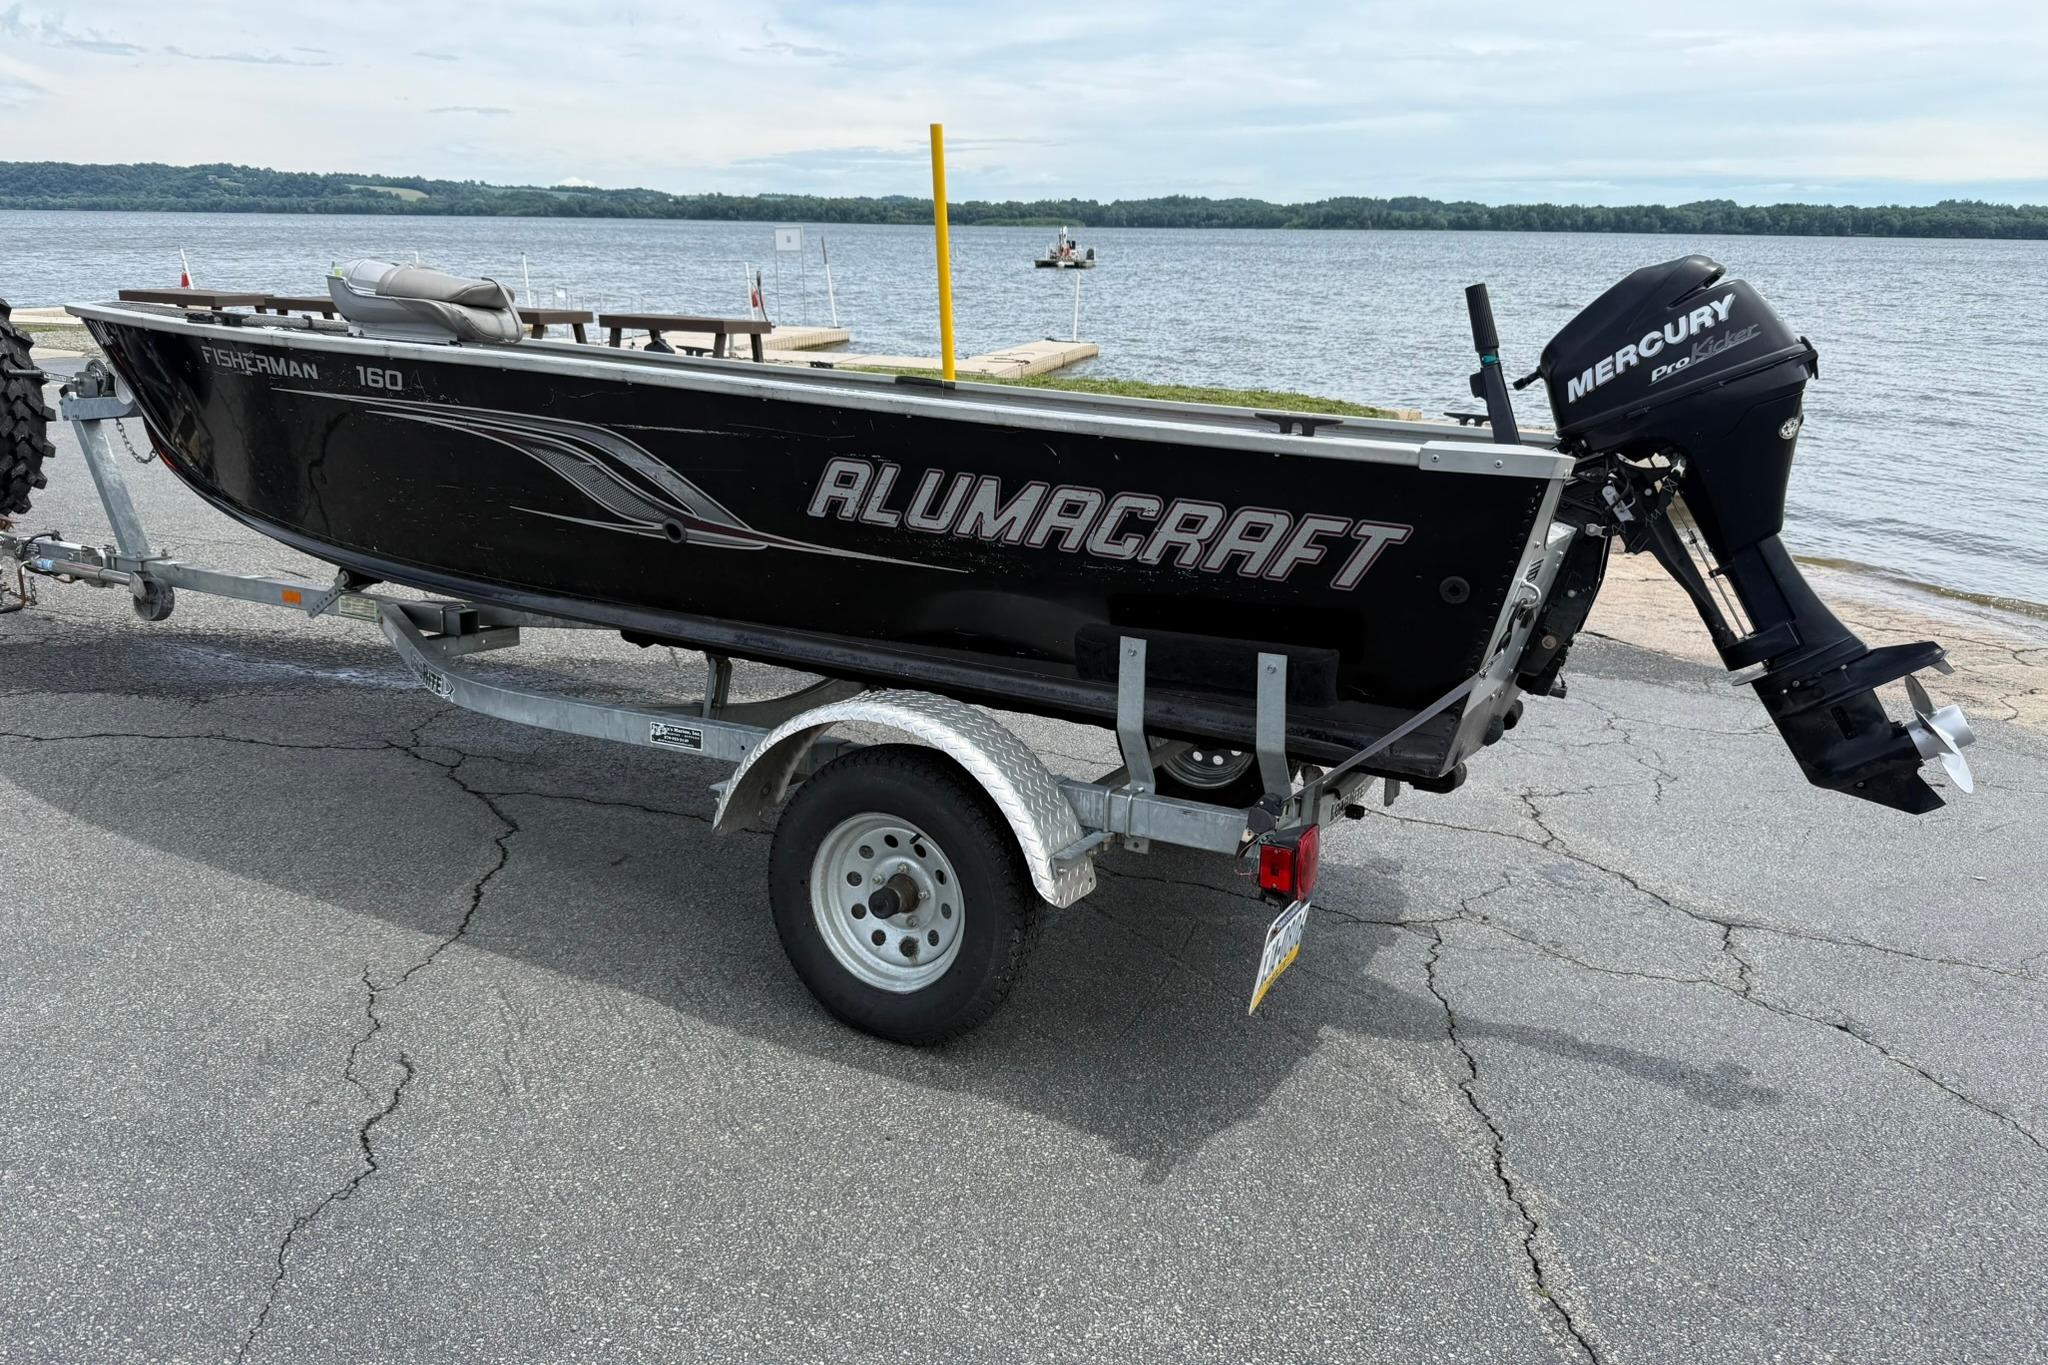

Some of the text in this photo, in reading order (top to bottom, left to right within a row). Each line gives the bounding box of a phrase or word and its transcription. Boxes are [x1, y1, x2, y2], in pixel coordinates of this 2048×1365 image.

[201, 346, 404, 391] FISHERMAN 160
[1567, 293, 1736, 404] MERCURY
[805, 456, 1414, 592] ALUMACRAFT
